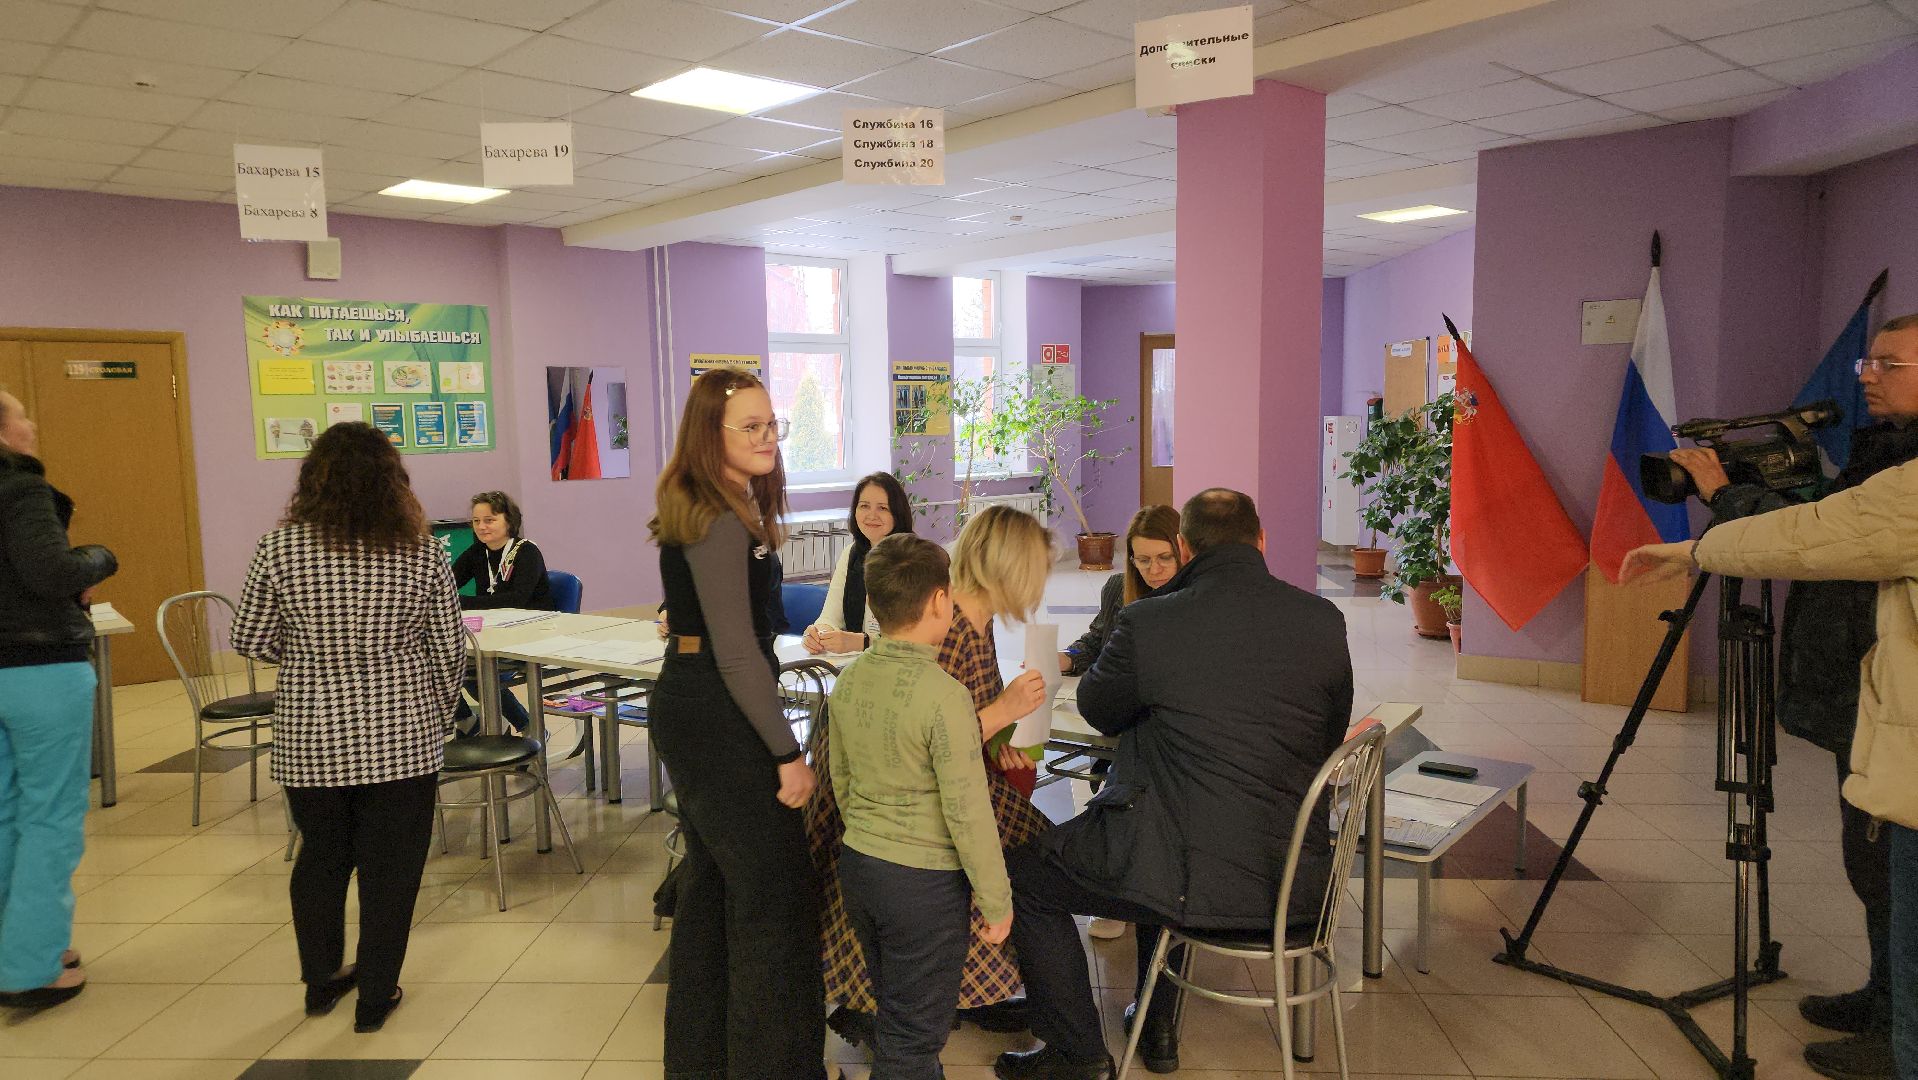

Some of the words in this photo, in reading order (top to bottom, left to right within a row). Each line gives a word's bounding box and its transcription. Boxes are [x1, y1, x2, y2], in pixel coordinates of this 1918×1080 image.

[852, 119, 915, 130] Службина
[919, 119, 934, 129] 16
[919, 139, 934, 149] 18
[484, 145, 548, 161] Бахарева
[554, 144, 569, 158] 19
[237, 162, 300, 178] Бахарева
[305, 166, 320, 178] 15
[919, 158, 934, 168] 20
[243, 204, 306, 220] Бахарева
[309, 207, 318, 219] 8
[269, 304, 303, 318] КАК
[308, 305, 411, 324] ПИТАЕШЬСЯ,
[325, 328, 354, 342] ТАК
[360, 329, 371, 342] И
[376, 329, 482, 345] УЛЫБАЕШЬСЯ
